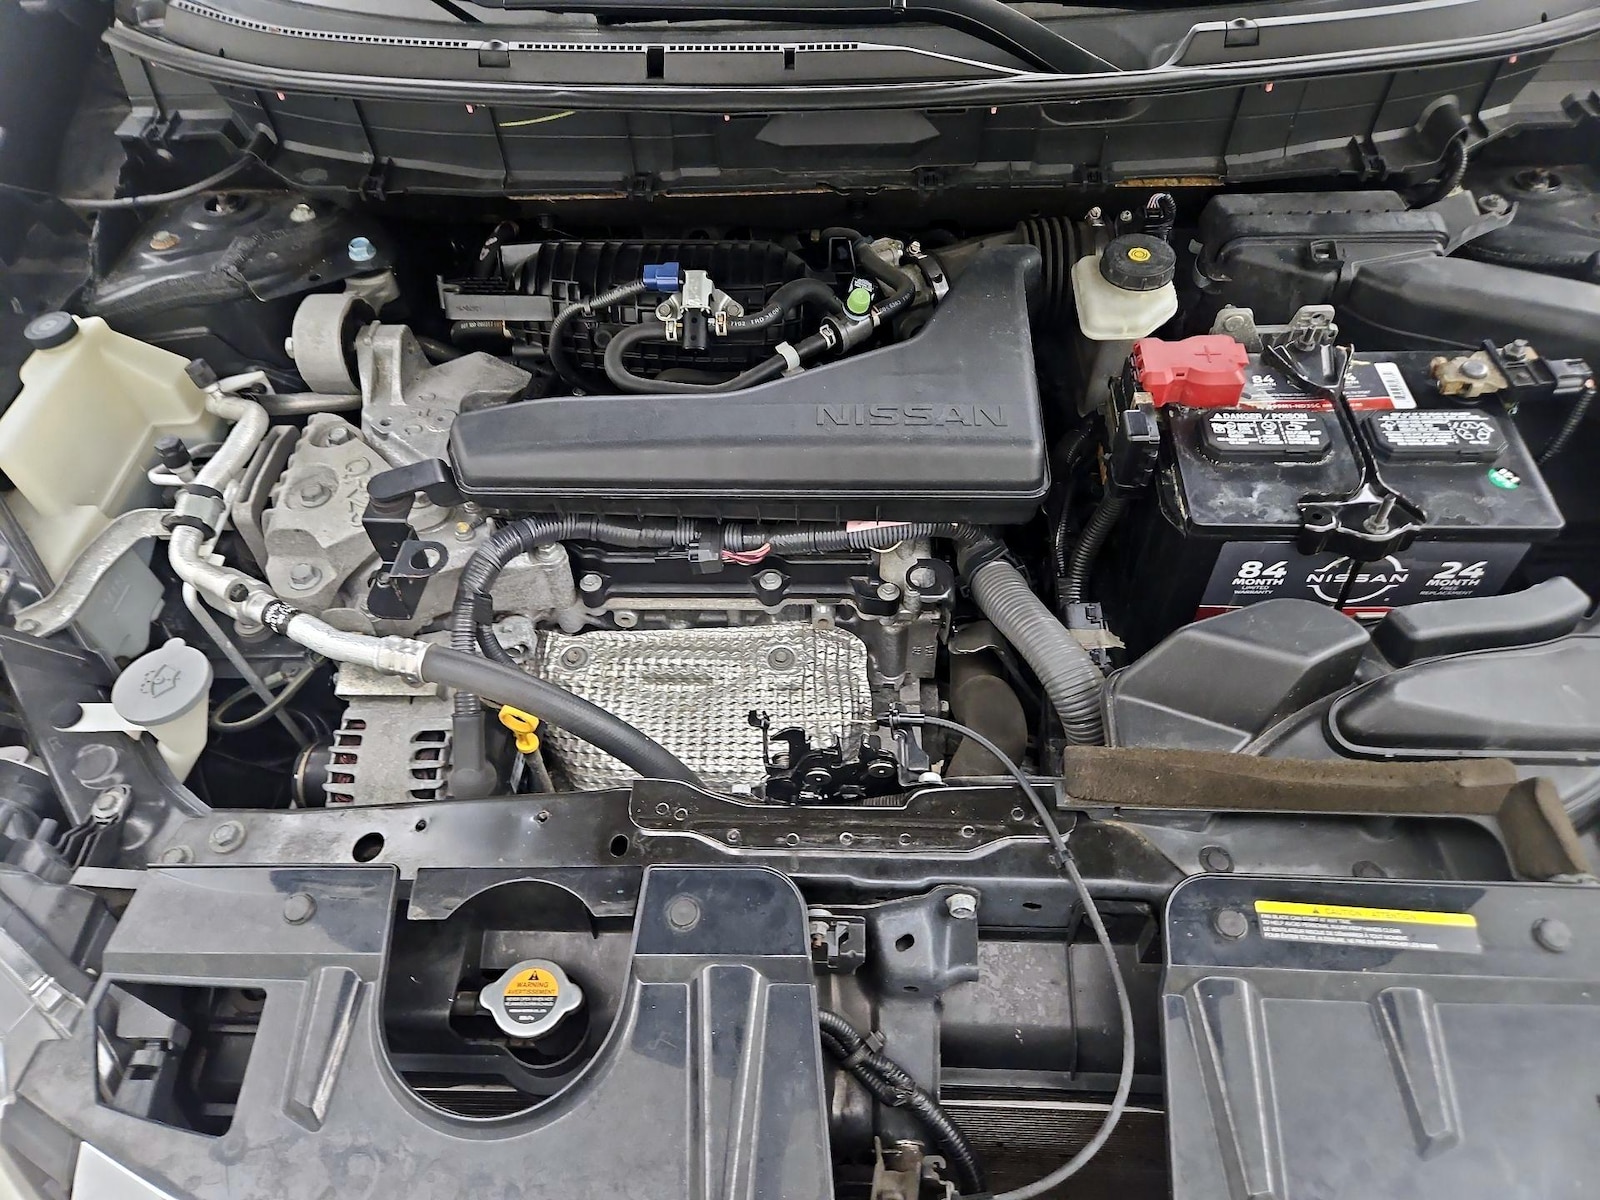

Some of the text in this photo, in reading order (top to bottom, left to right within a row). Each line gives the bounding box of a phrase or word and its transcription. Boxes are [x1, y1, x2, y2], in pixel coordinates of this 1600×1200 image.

[1251, 374, 1275, 384] 84
[815, 403, 1009, 427] NISSAN
[1223, 412, 1263, 420] DANGER
[1271, 412, 1309, 420] POISON
[1237, 560, 1489, 579] 84 24
[1231, 578, 1285, 586] MONTH
[1305, 573, 1410, 583] NISSAN
[1425, 579, 1481, 587] MONTH
[1324, 907, 1362, 917] CAUTION
